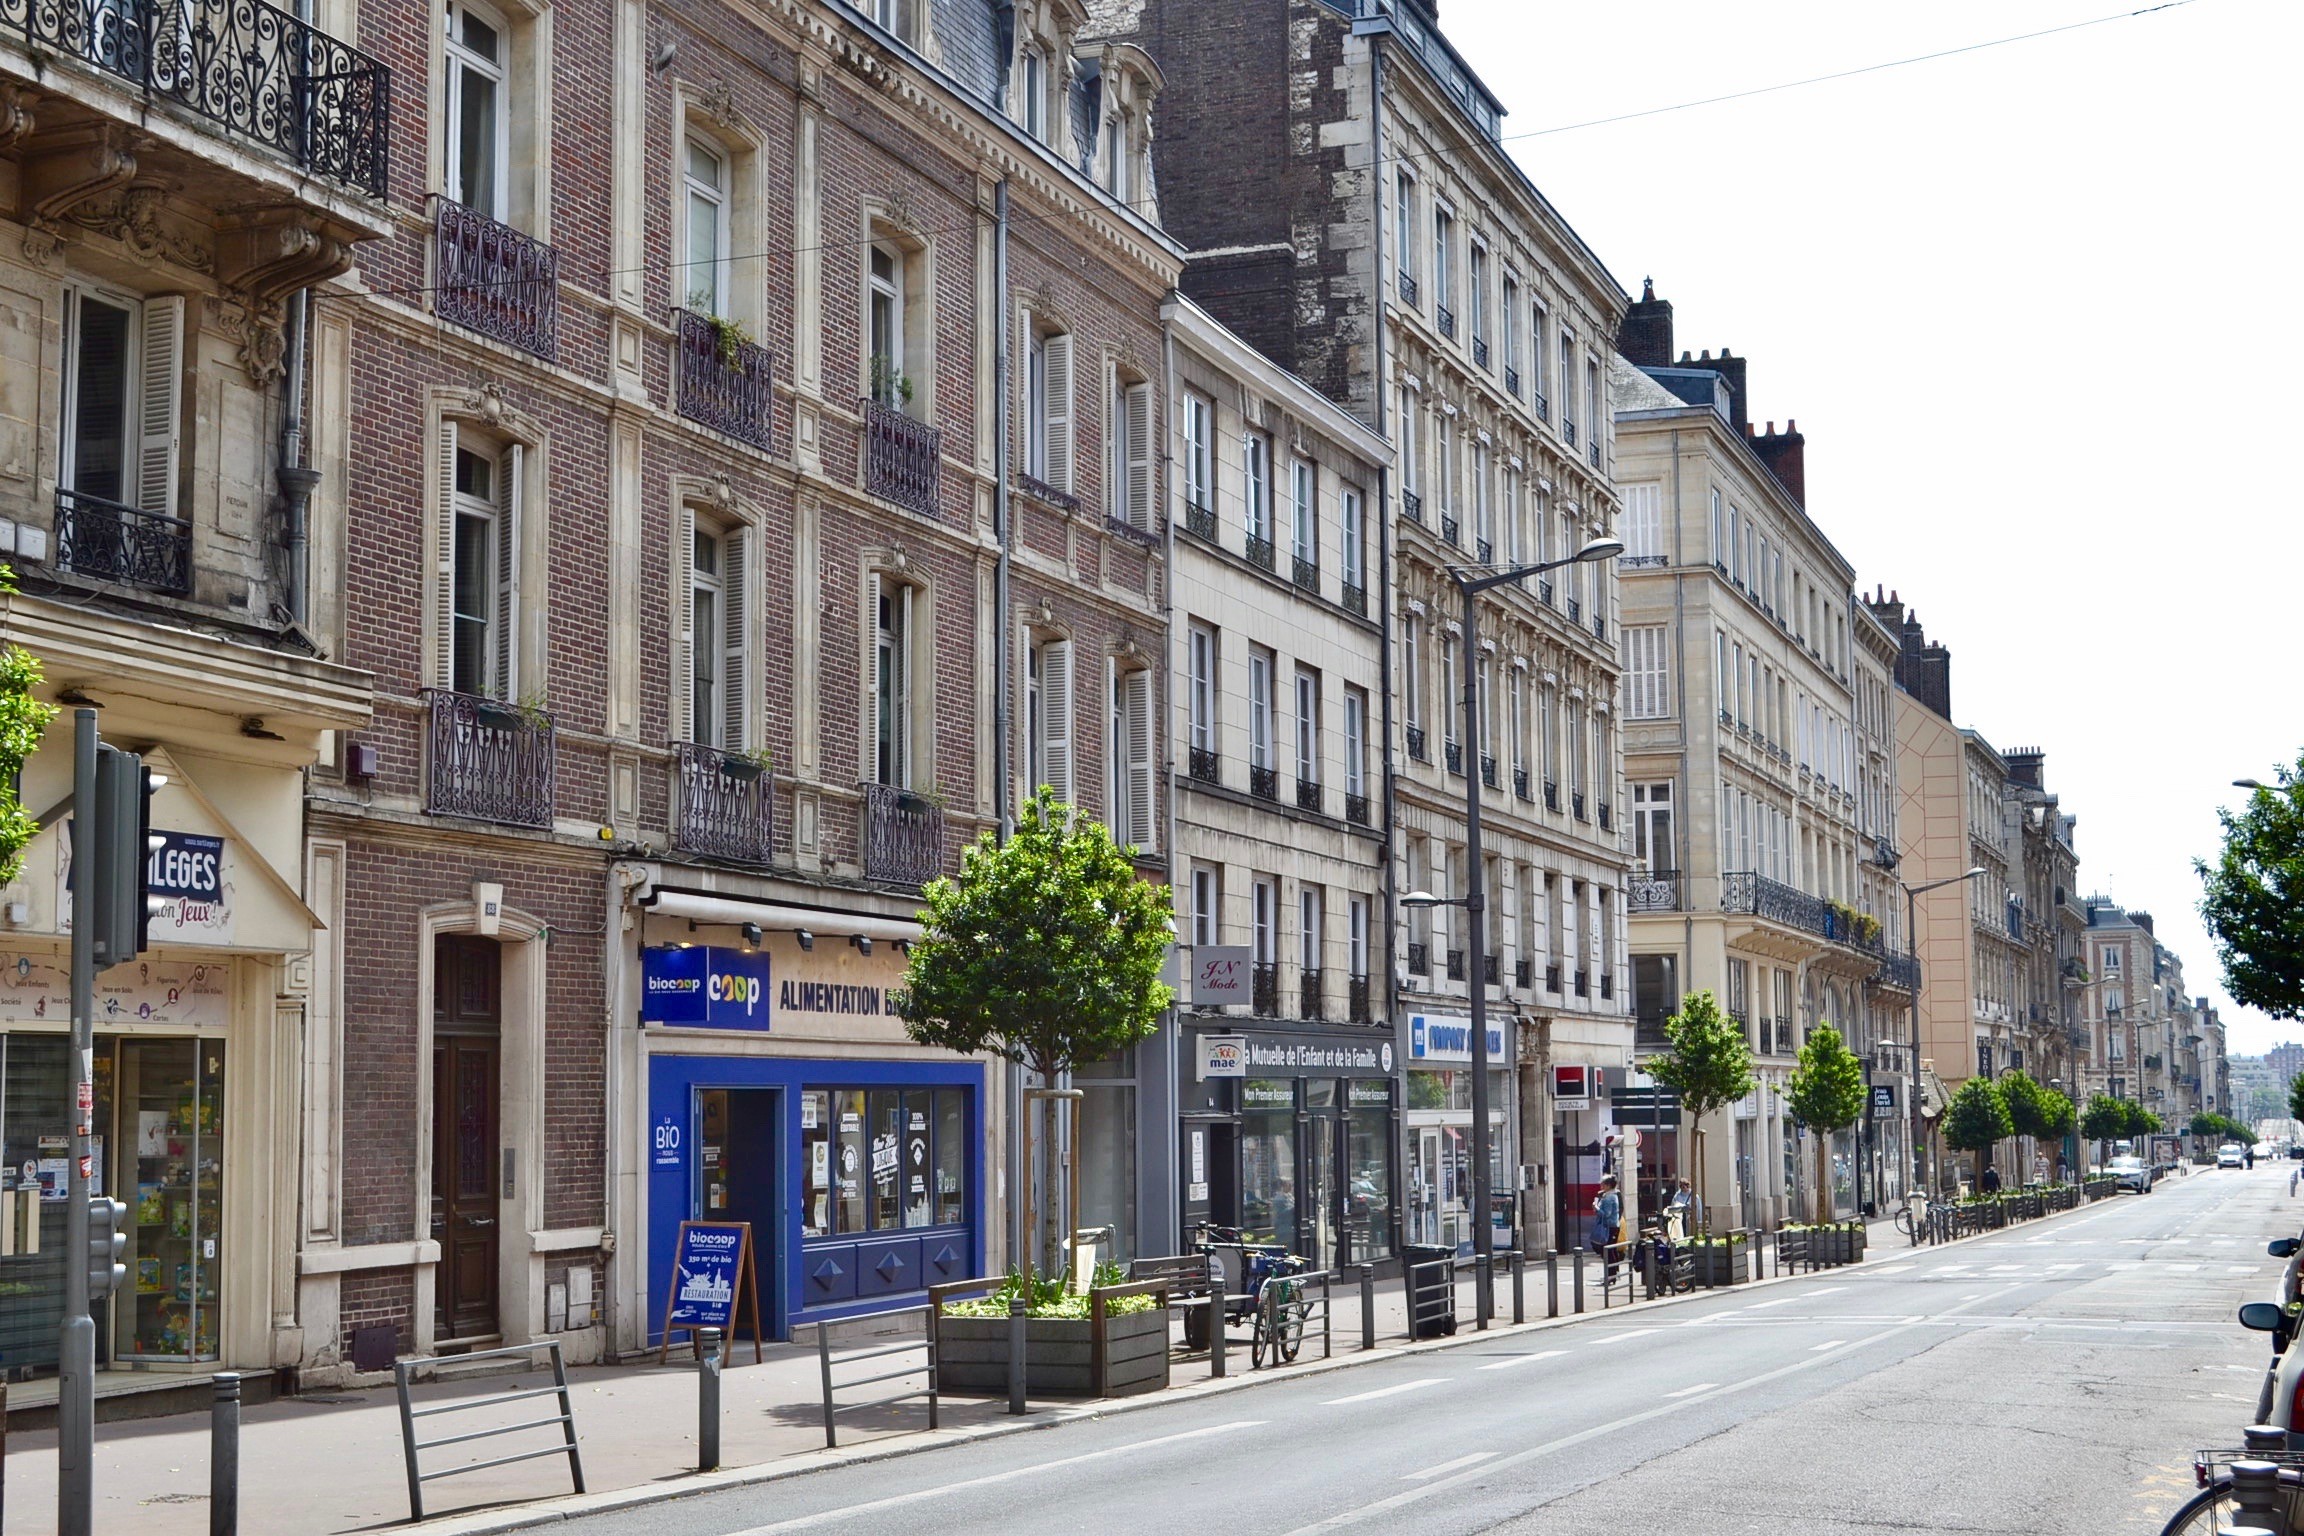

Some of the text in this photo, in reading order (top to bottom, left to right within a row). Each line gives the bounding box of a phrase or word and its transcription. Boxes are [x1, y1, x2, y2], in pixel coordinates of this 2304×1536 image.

[148, 849, 216, 891] ILEGES
[648, 976, 700, 993] biocoop
[1203, 978, 1238, 990] Mode
[708, 974, 760, 1017] coop
[780, 980, 879, 1016] ALIMENTATION
[1210, 1059, 1236, 1068] mae
[1251, 1044, 1285, 1066] Mutuelle
[1286, 1046, 1296, 1066] de
[1297, 1046, 1326, 1067] l'Enfant
[1326, 1049, 1334, 1067] et
[1335, 1048, 1344, 1067] de
[1345, 1048, 1351, 1067] la
[1352, 1048, 1377, 1068] Famille
[1244, 1088, 1294, 1101] Mon Premier Assureur
[689, 1230, 736, 1248] biocoop
[711, 1255, 720, 1263] de
[721, 1255, 732, 1263] bio
[683, 1288, 729, 1300] RESTAURATION
